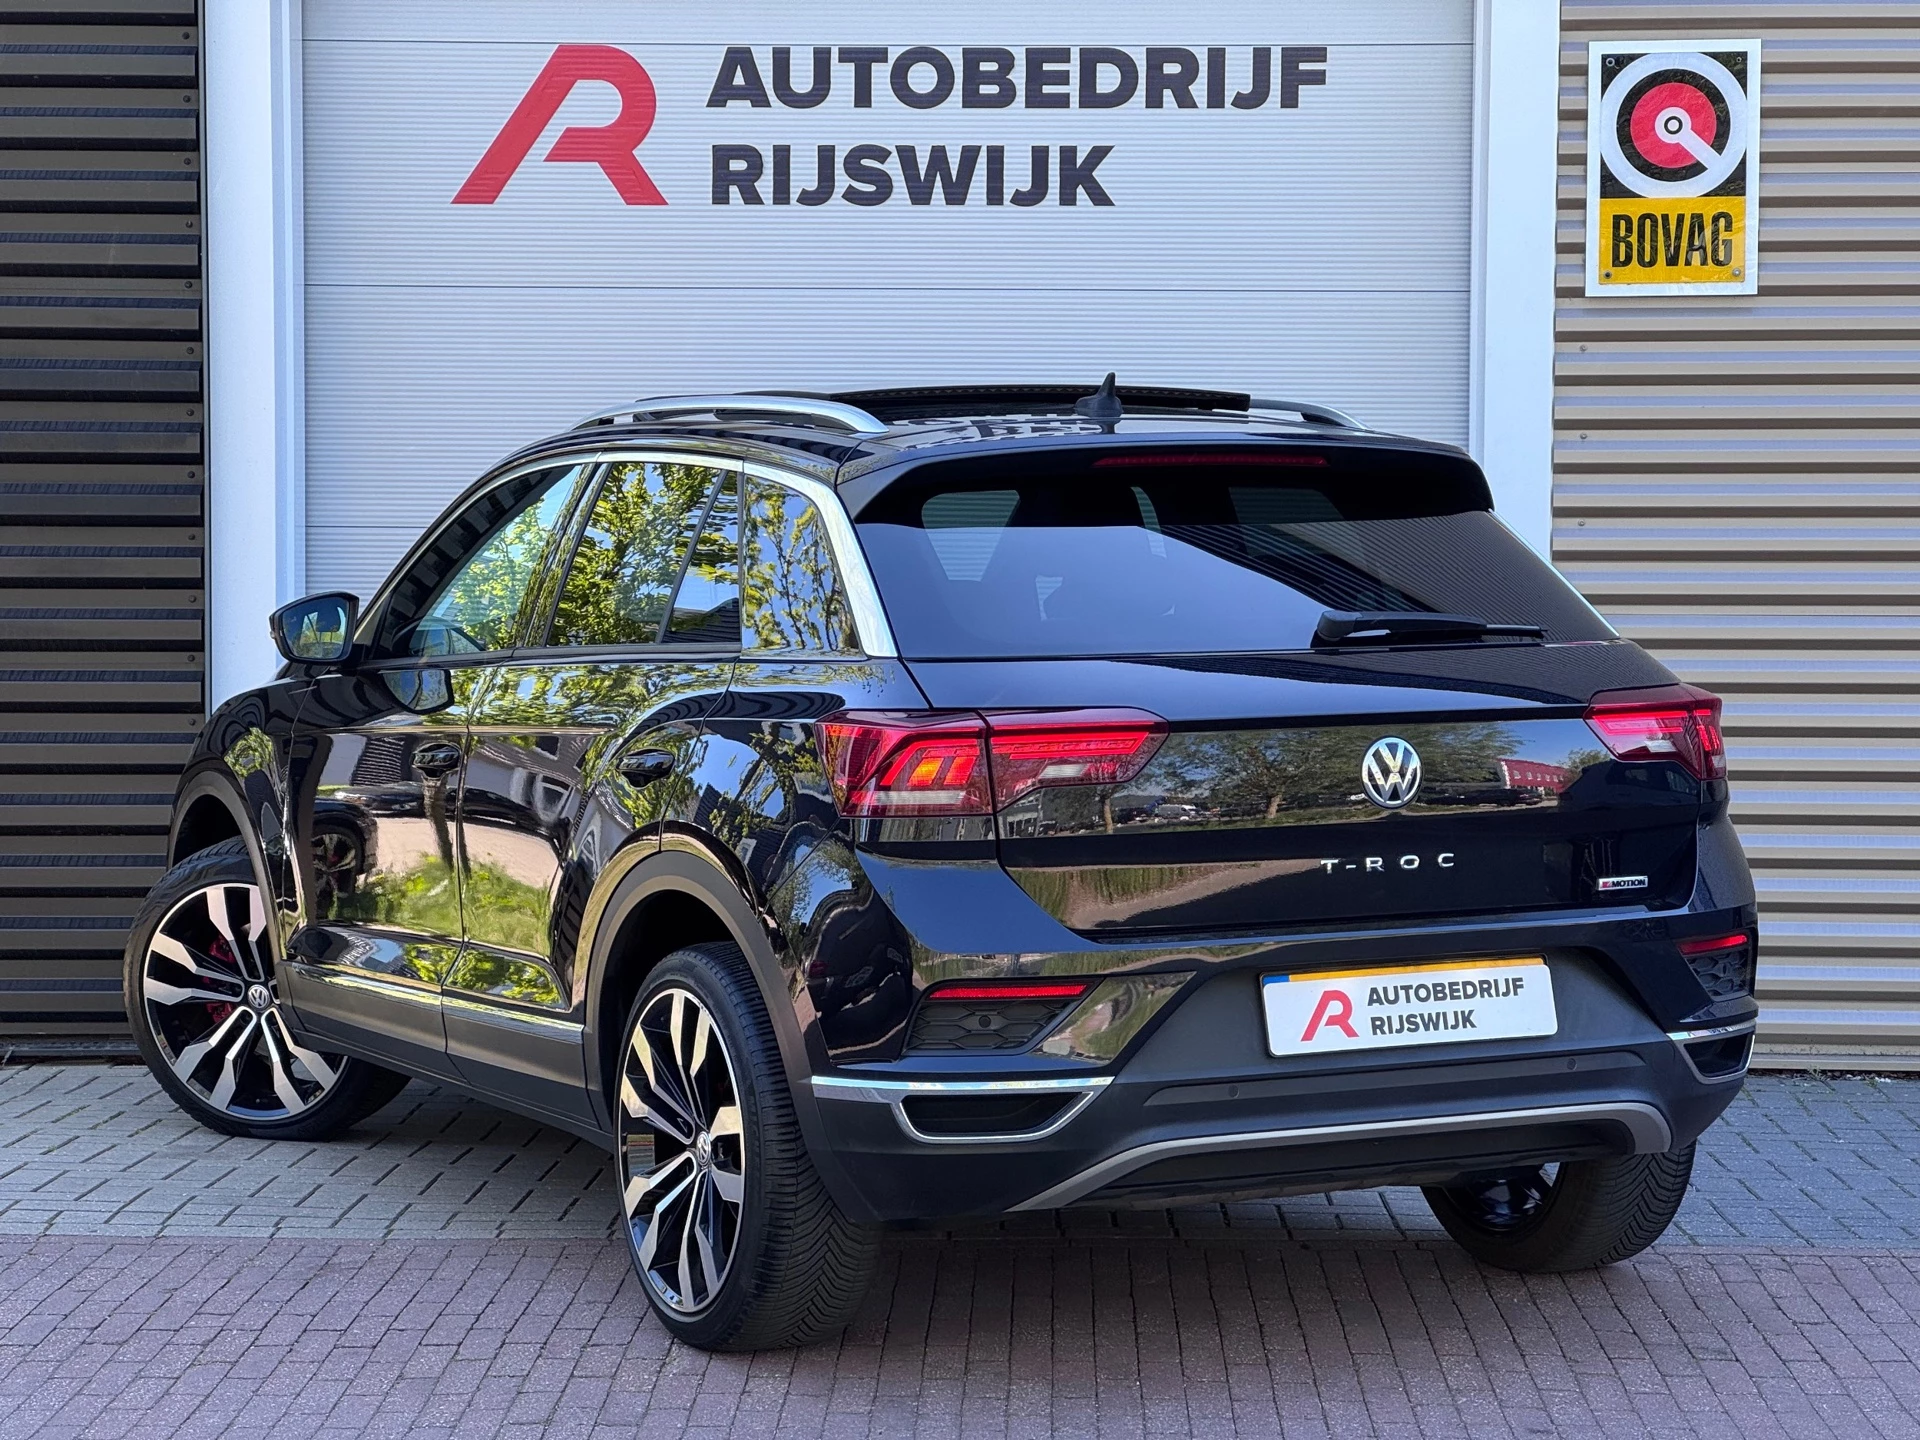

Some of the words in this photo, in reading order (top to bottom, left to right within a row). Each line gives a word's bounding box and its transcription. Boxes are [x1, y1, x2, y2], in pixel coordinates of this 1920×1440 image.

[706, 46, 1328, 110] AUTOBEDRIJF
[711, 144, 1115, 207] RIJSWIJK
[1611, 211, 1733, 268] BOVAG
[1367, 977, 1525, 1007] AUTOBEDRIJF
[1370, 1009, 1477, 1036] RIJSWIJK
